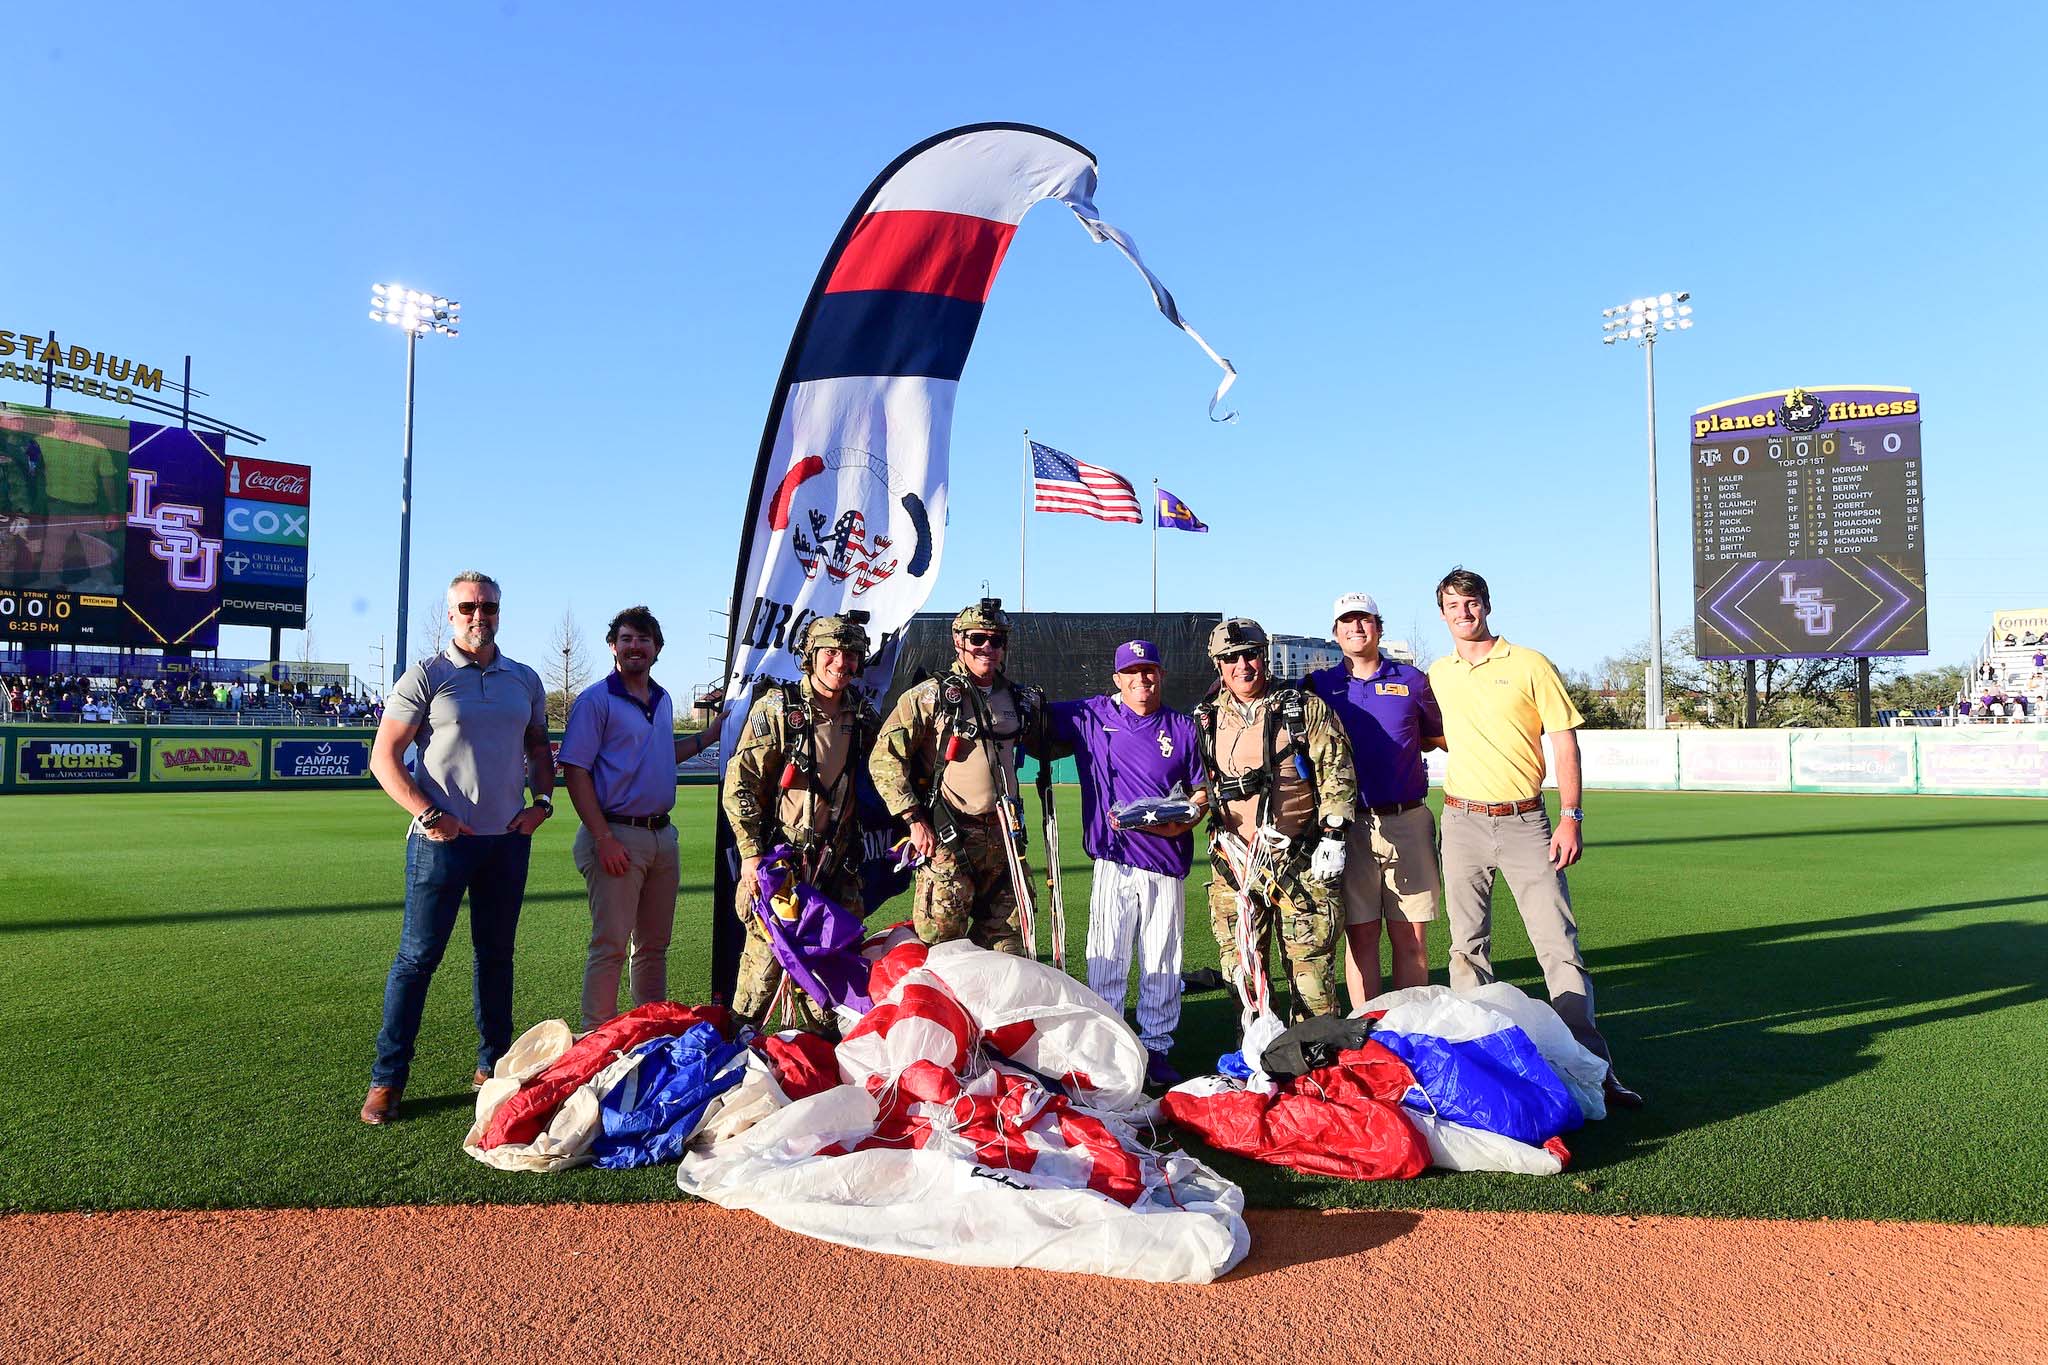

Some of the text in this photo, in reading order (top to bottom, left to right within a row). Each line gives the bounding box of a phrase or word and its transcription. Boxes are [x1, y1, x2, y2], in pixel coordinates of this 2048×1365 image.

[54, 371, 134, 404] FIELD
[1790, 404, 1813, 420] pf
[1828, 400, 1918, 421] fitness
[1694, 410, 1776, 438] planet
[1769, 440, 1835, 459] 0 0 0
[1849, 436, 1866, 455] LSU
[1882, 433, 1902, 452] 0
[1732, 446, 1750, 465] 0
[1832, 465, 1868, 474] MORGAN
[245, 470, 306, 495] Coca-Cola
[1719, 475, 1743, 484] KALER
[1832, 475, 1862, 483] CREWS
[1833, 492, 1873, 500] DOUGHTY
[1719, 500, 1756, 508] CLAUNCH
[1833, 509, 1881, 518] THOMPSON
[227, 508, 306, 538] COX
[1834, 518, 1882, 527] DIGIACOMO
[126, 468, 222, 592] LSU
[1834, 528, 1873, 536] PEARSON
[1834, 536, 1878, 545] MCMANUS
[252, 553, 295, 564] OUR LADY
[264, 563, 281, 572] THE
[282, 564, 304, 573] LAKE
[0, 598, 70, 618] 0 0 0
[222, 599, 303, 613] POWERADE
[1779, 572, 1836, 636] LSU
[9, 621, 59, 632] 6:25 PM
[1128, 640, 1145, 657] LSU
[156, 664, 190, 673] LSU
[1376, 683, 1410, 697] LSU
[50, 744, 112, 756] MORE
[1157, 730, 1174, 758] LSU
[37, 754, 123, 769] TIGERS
[161, 747, 252, 768] MANDA
[295, 755, 350, 765] CAMPUS
[294, 766, 350, 776] FEDERAL
